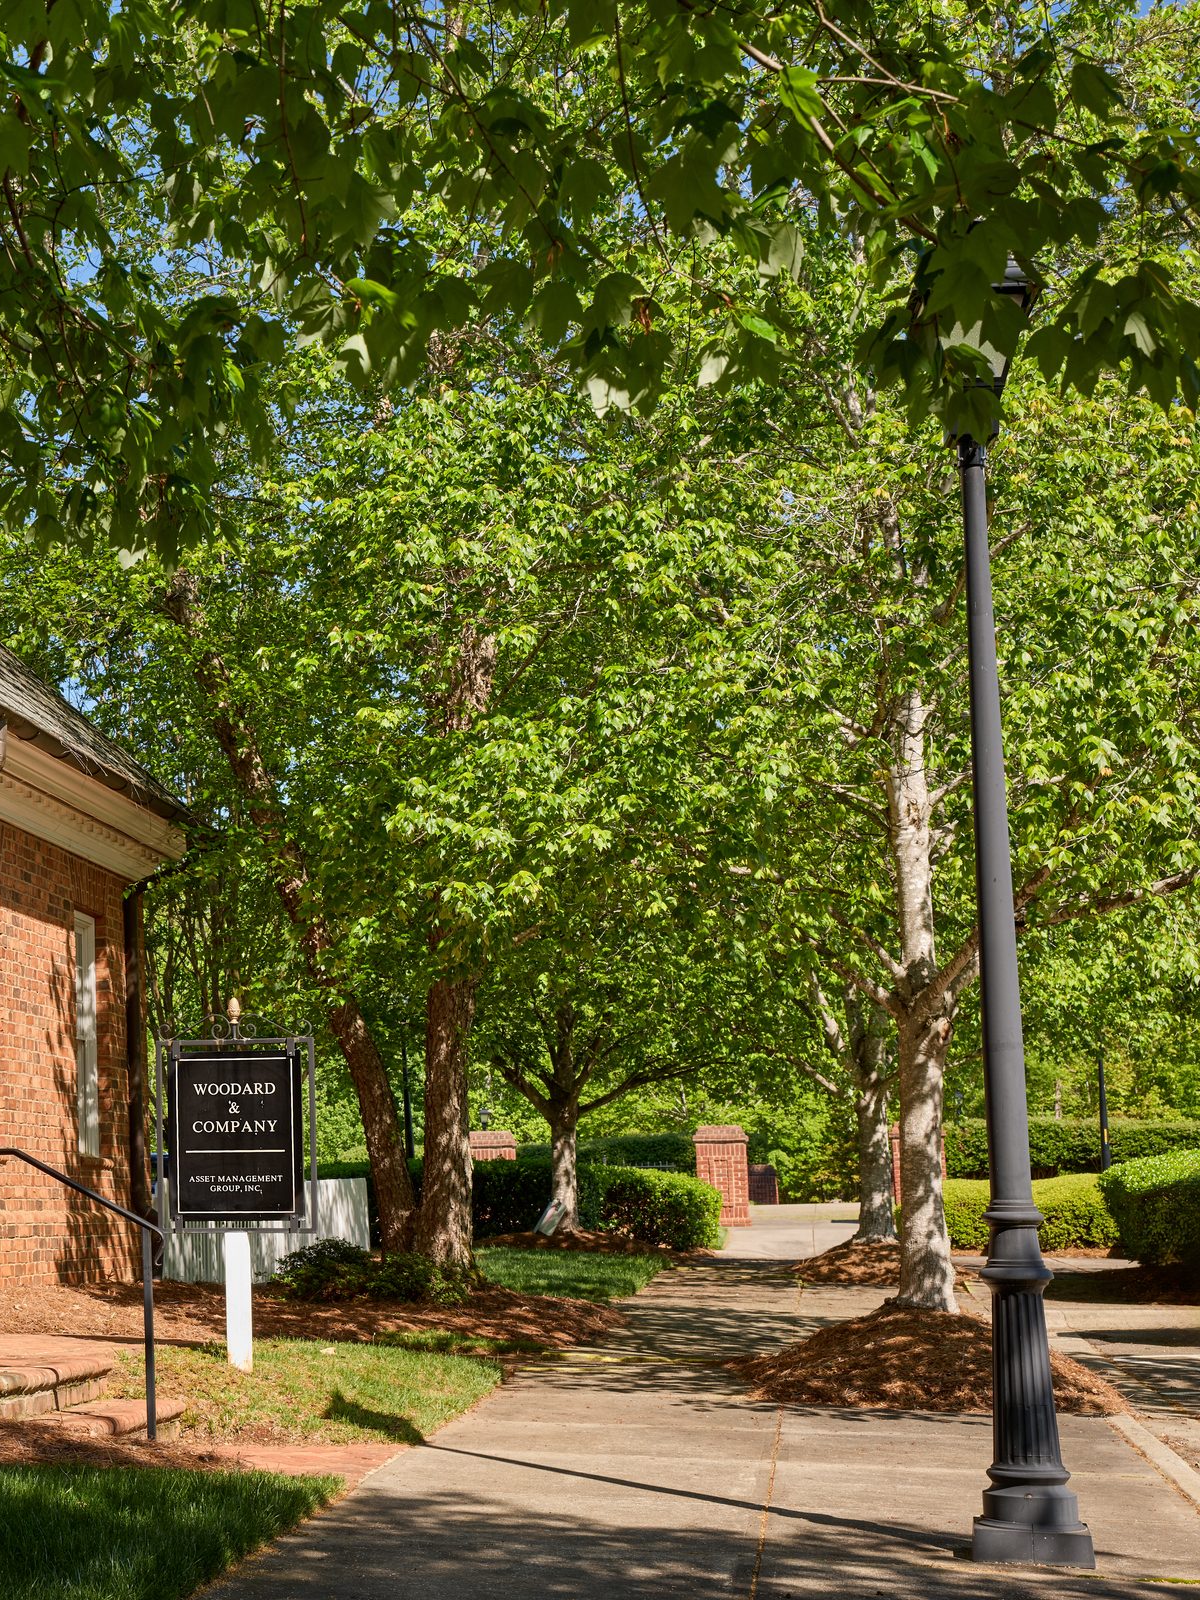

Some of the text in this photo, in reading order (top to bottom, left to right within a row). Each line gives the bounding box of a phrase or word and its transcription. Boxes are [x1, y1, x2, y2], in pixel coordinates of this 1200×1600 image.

[192, 1082, 276, 1096] WOODARD
[228, 1101, 240, 1114] &
[192, 1119, 278, 1133] COMPANY
[188, 1174, 283, 1183] ASSET MANAGEMENT
[209, 1184, 243, 1193] GROUP,
